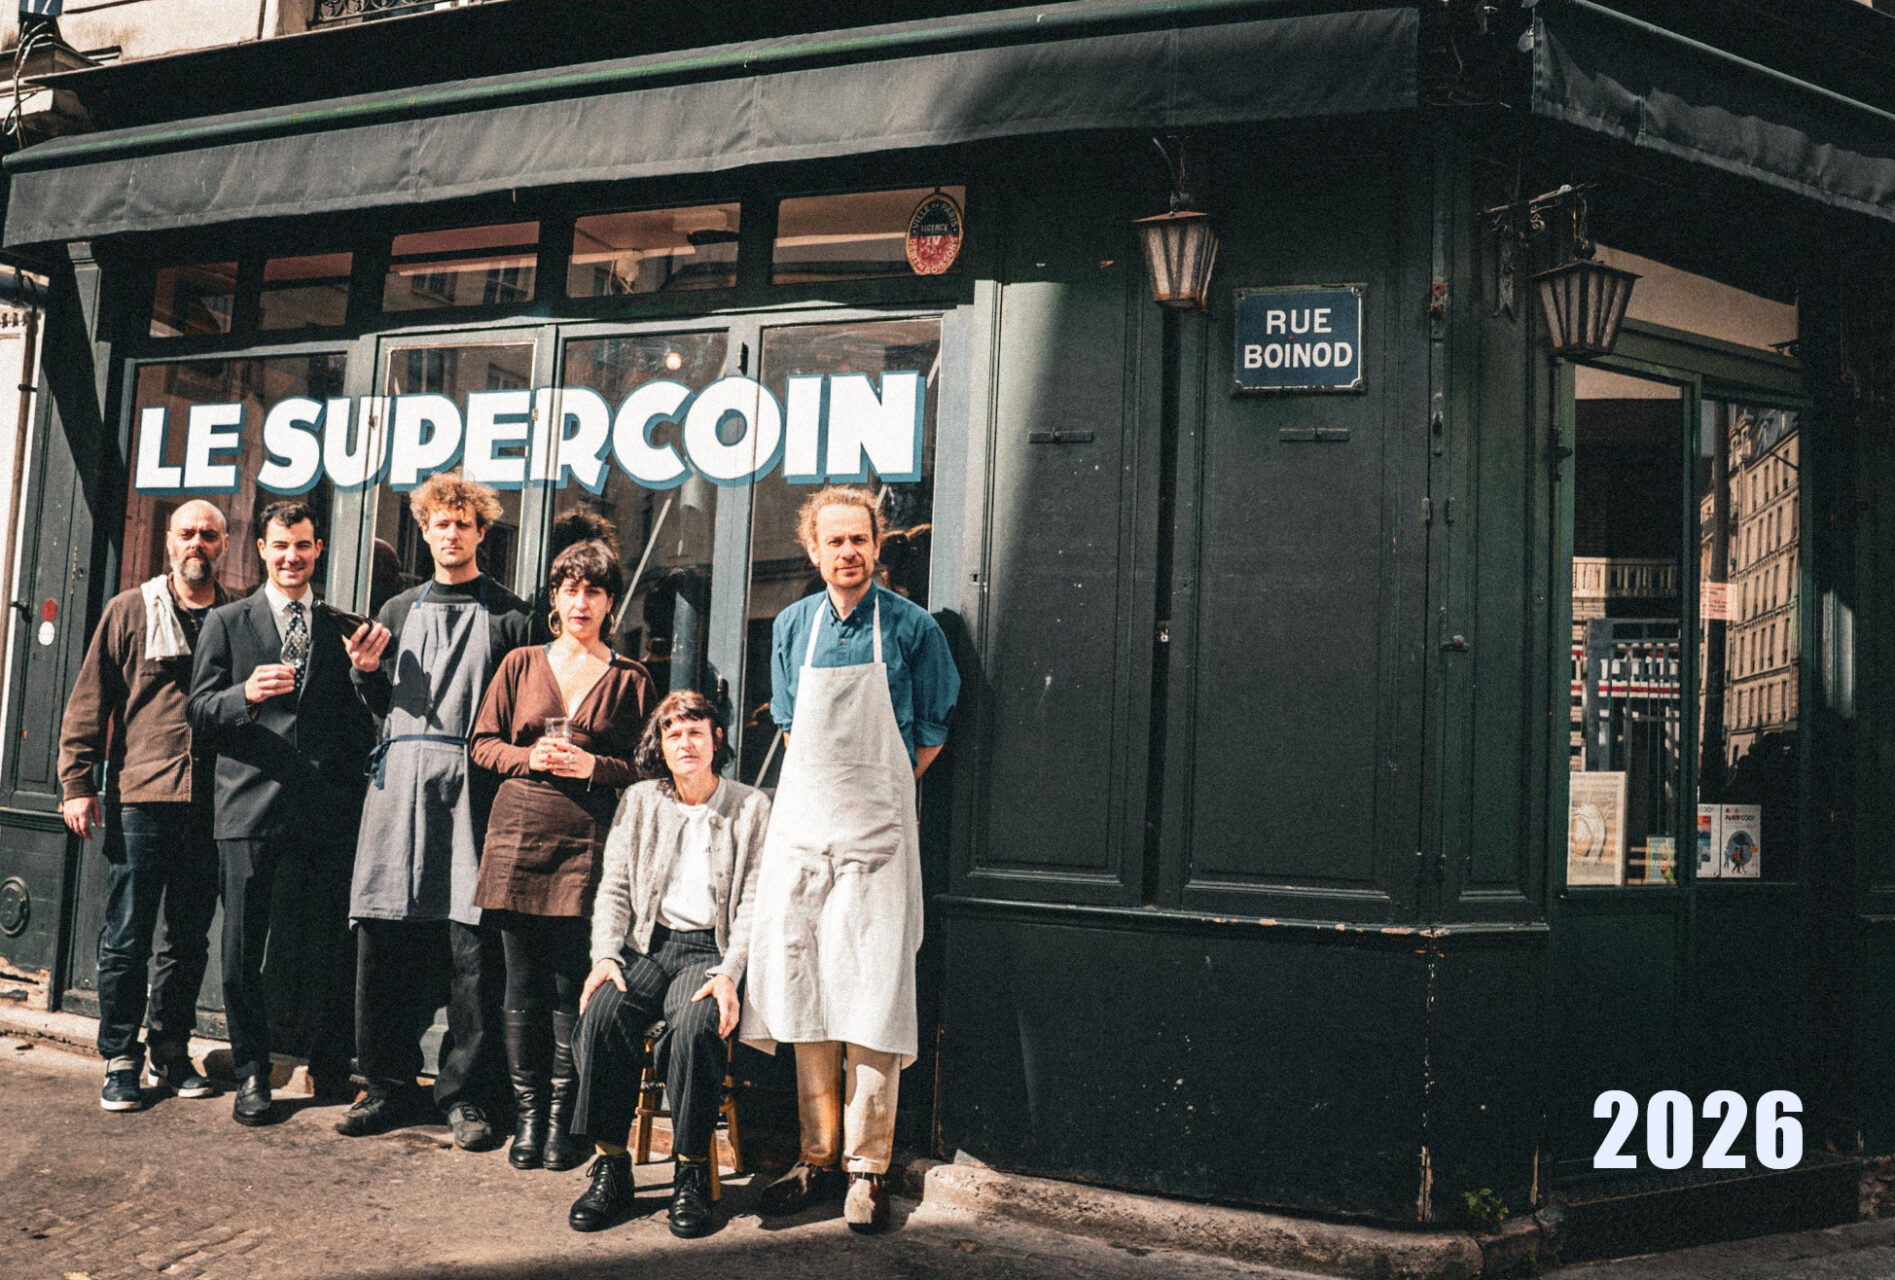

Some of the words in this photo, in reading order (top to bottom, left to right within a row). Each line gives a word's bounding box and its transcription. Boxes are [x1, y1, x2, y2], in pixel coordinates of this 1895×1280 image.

[912, 205, 931, 230] VILLE
[941, 202, 958, 228] PARIS
[921, 224, 948, 232] LICENCE
[1266, 308, 1332, 335] RUE
[1244, 342, 1353, 369] BOINOD
[135, 403, 245, 495] LE
[257, 370, 926, 496] SUPERCOIN
